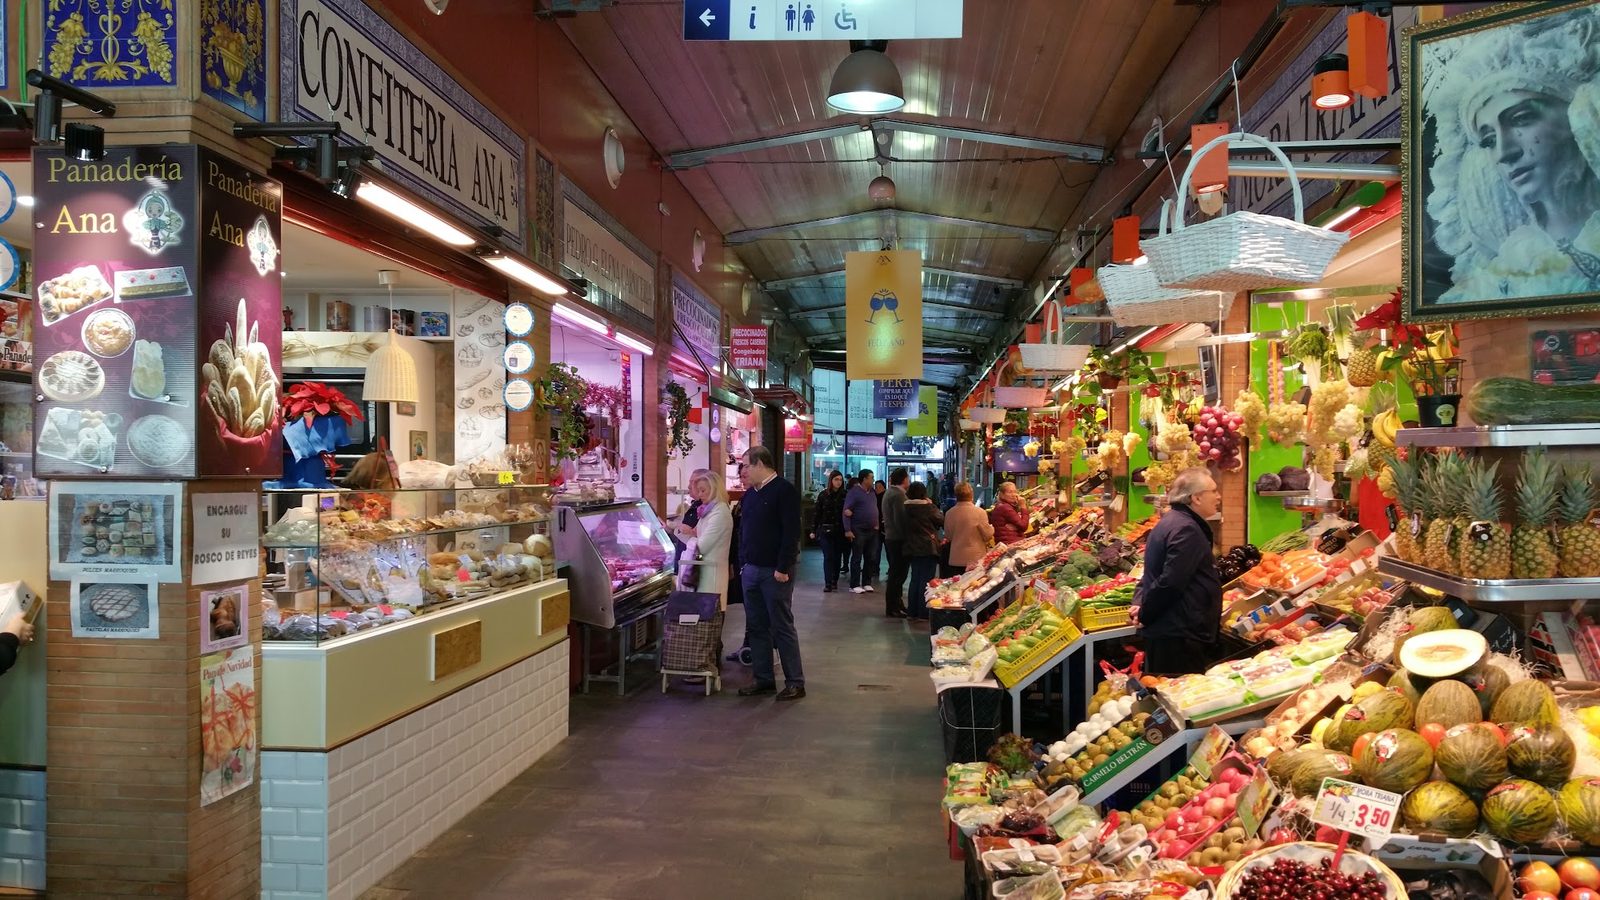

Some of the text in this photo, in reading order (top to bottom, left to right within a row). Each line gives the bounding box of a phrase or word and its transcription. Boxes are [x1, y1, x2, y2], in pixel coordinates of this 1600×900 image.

[300, 10, 508, 221] CONFITERIA ANA
[48, 155, 183, 183] Panadería
[51, 204, 118, 235] Ana
[209, 210, 245, 248] Ana
[732, 328, 767, 337] PRECOCINADOS
[733, 347, 766, 356] Congelados
[735, 357, 764, 367] TRIANA
[880, 400, 913, 408] TE ESPERA
[207, 505, 248, 516] ENCARGUE
[221, 527, 231, 538] SU
[194, 548, 257, 565] ROSCO DE REYES
[226, 656, 252, 673] Navidad
[1083, 740, 1148, 787] CARMELO BELTRÁN
[1357, 787, 1395, 802] MORA TRIANA
